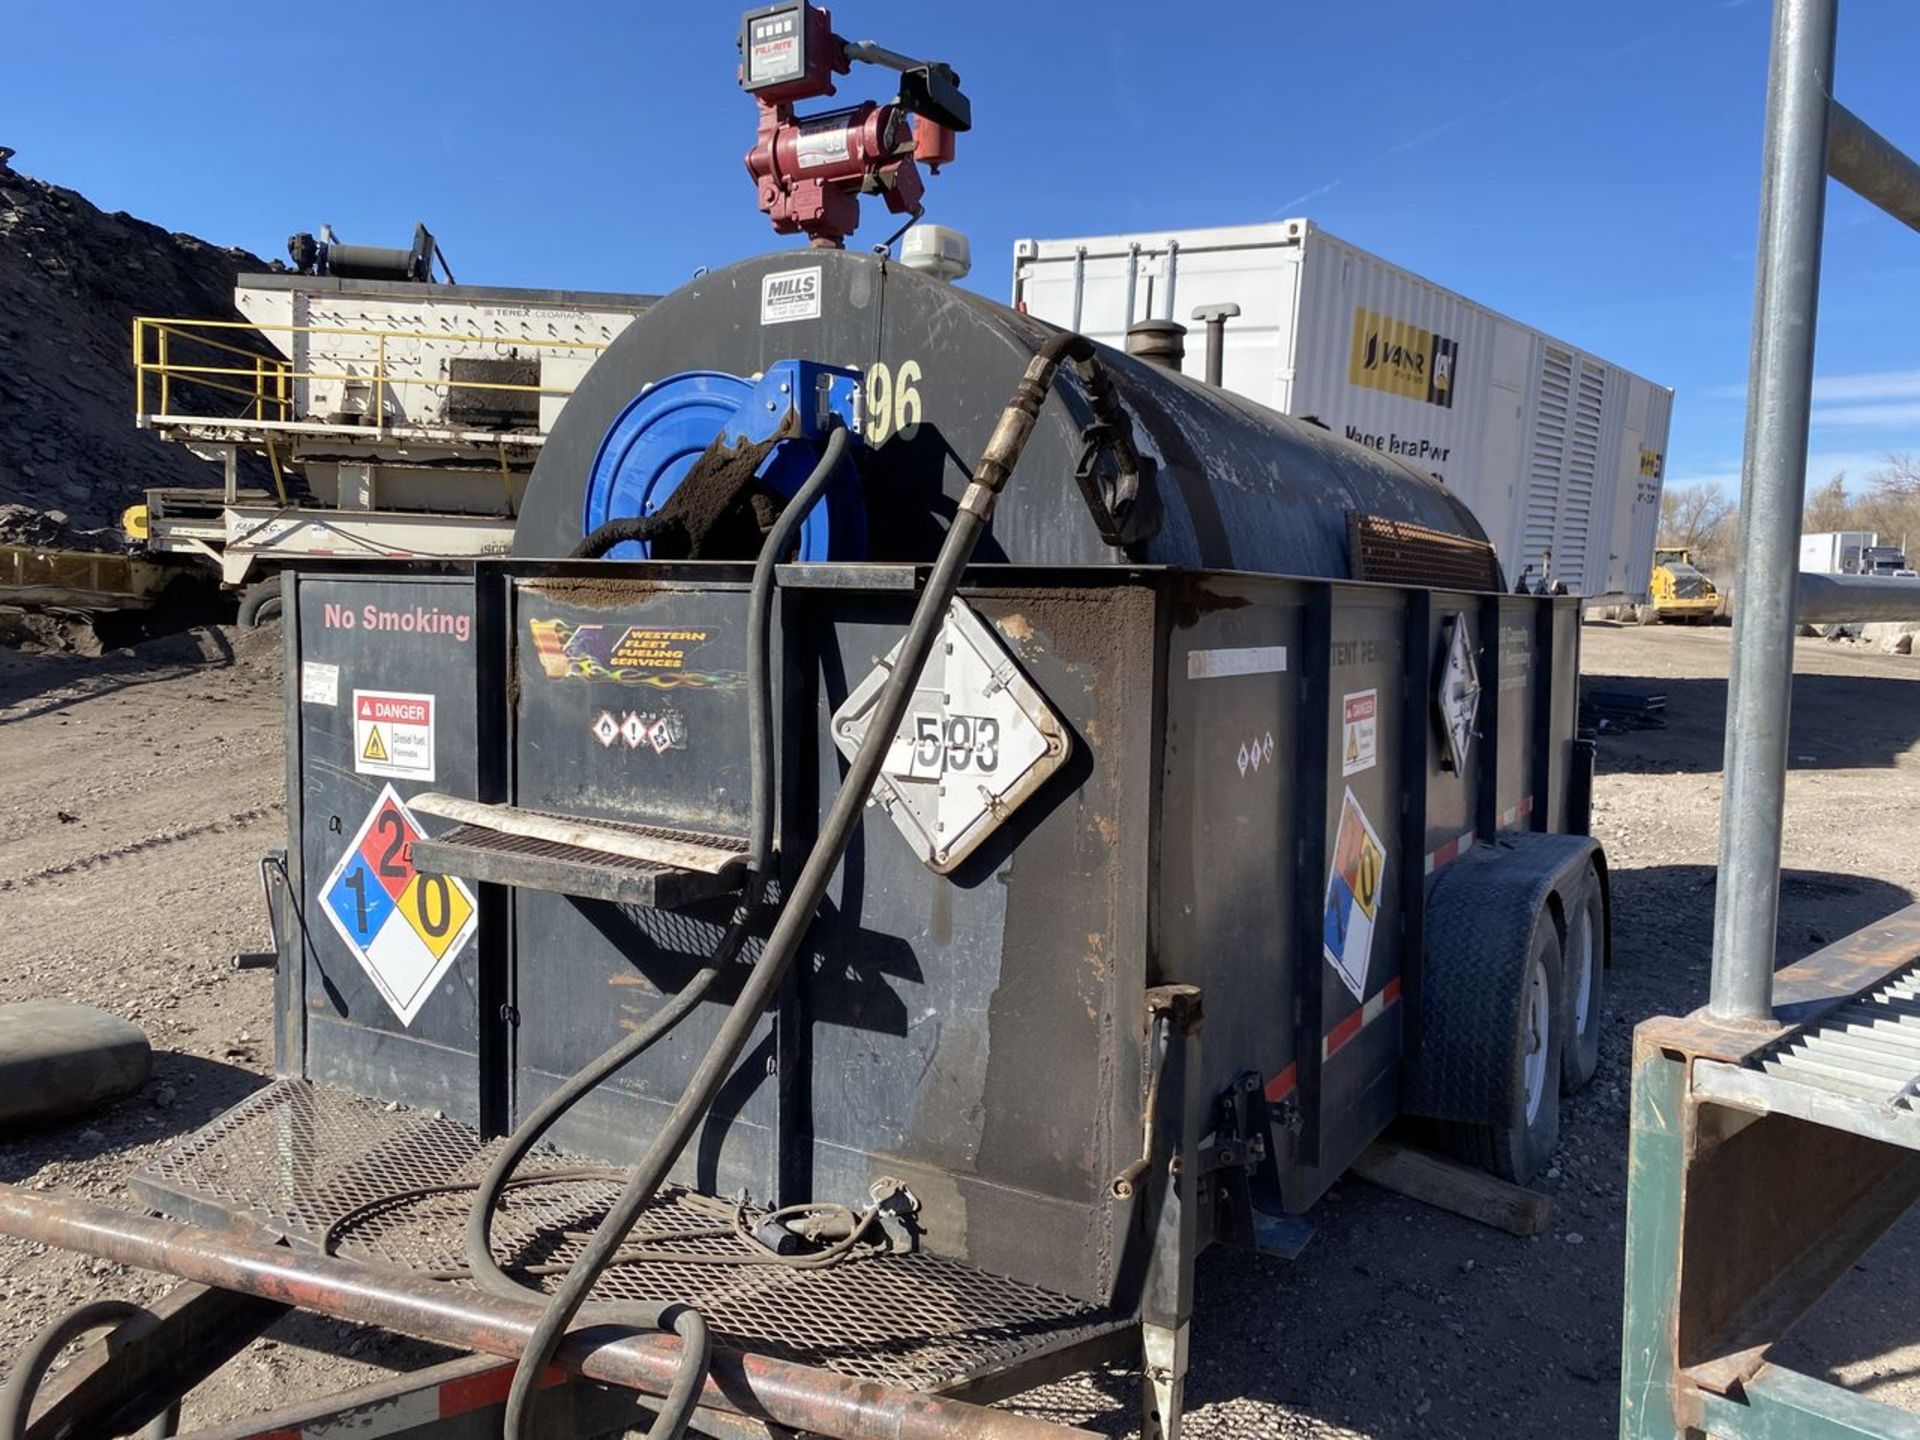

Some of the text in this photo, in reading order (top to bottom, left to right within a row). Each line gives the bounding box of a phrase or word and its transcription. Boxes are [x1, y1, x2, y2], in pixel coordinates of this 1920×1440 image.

[768, 276, 815, 297] MILLS
[846, 360, 922, 442] 96
[324, 603, 472, 642] No Smoking
[631, 630, 707, 641] WESTERN
[617, 648, 684, 659] FUELING
[624, 639, 670, 649] FLEET
[610, 657, 682, 668] SERVICES
[375, 703, 425, 721] DANGER
[916, 717, 1000, 773] 593
[378, 809, 407, 878] 2
[1362, 846, 1375, 906] 0
[345, 867, 451, 938] 1 0
